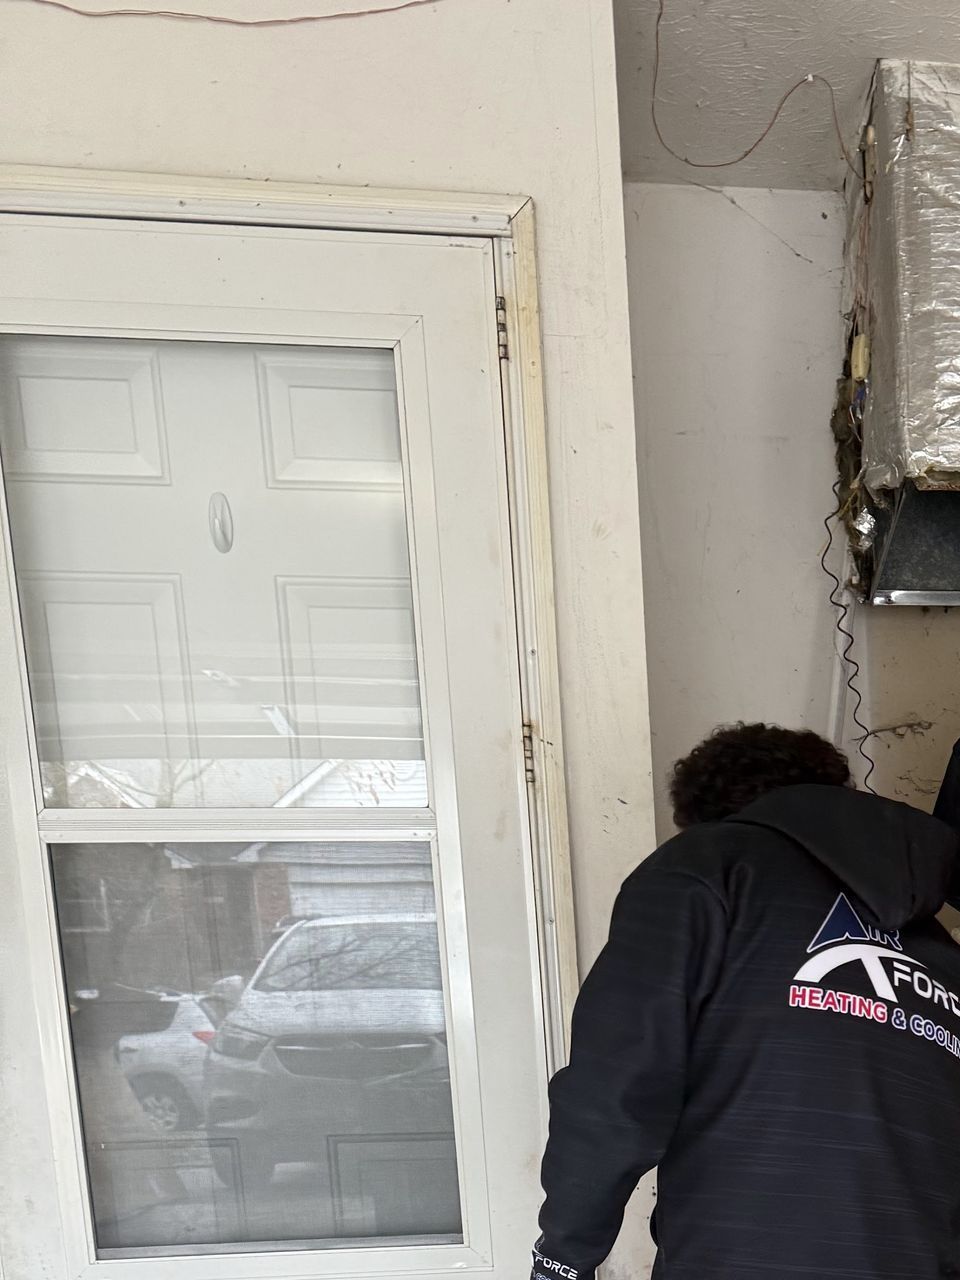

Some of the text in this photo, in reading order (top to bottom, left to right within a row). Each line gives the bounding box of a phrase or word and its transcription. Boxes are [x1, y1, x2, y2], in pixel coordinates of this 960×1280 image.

[789, 985, 888, 1023] HEATING
[891, 1008, 907, 1030] &
[535, 1255, 578, 1280] FORCE
